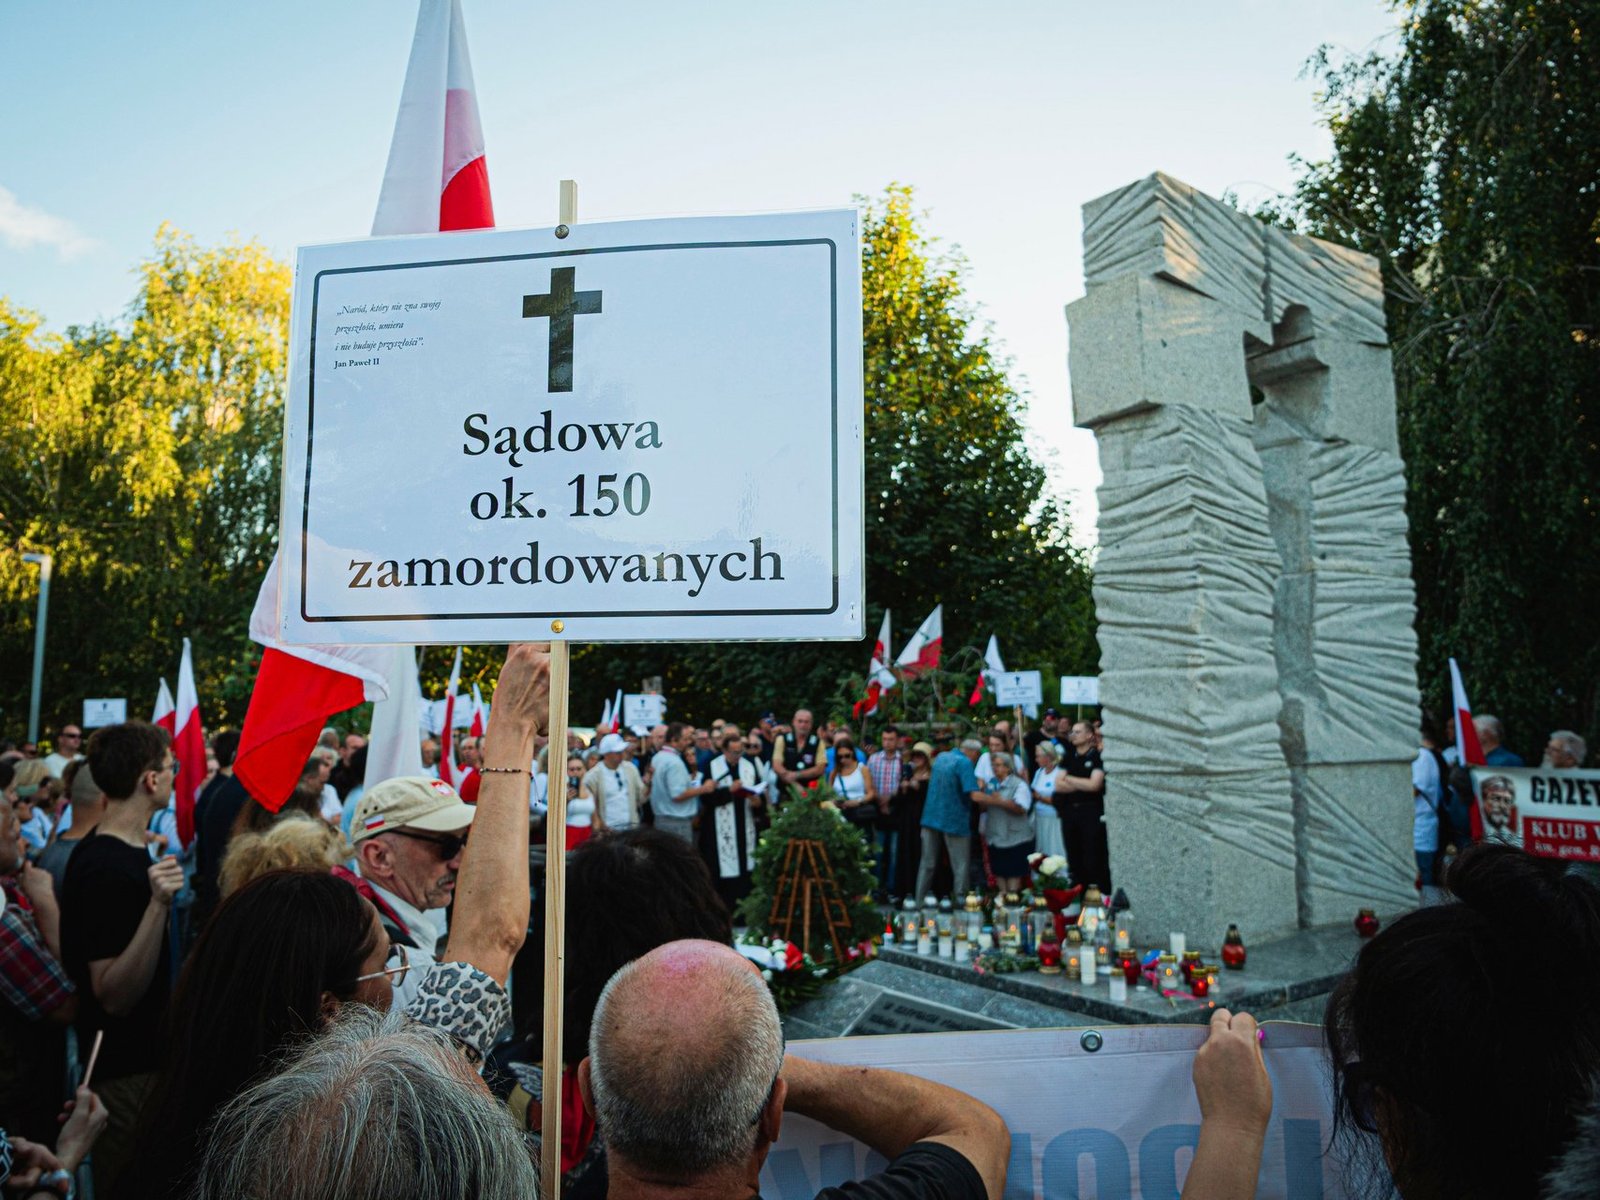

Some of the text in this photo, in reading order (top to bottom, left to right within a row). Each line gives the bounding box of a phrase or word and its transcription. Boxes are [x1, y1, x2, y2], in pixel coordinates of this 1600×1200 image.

[370, 304, 389, 314] który
[391, 302, 402, 311] nie
[404, 303, 418, 312] zna
[420, 300, 441, 311] swojej
[335, 321, 404, 335] przeszłości, umiera
[335, 343, 339, 351] i
[340, 343, 351, 351] nie
[353, 341, 377, 351] buduje
[334, 360, 347, 370] Jan
[349, 359, 371, 367] Paweł
[463, 410, 663, 468] Sądowa
[471, 473, 651, 521] ok. 150
[348, 537, 785, 598] zamordowanych
[1531, 821, 1588, 841] KLUB
